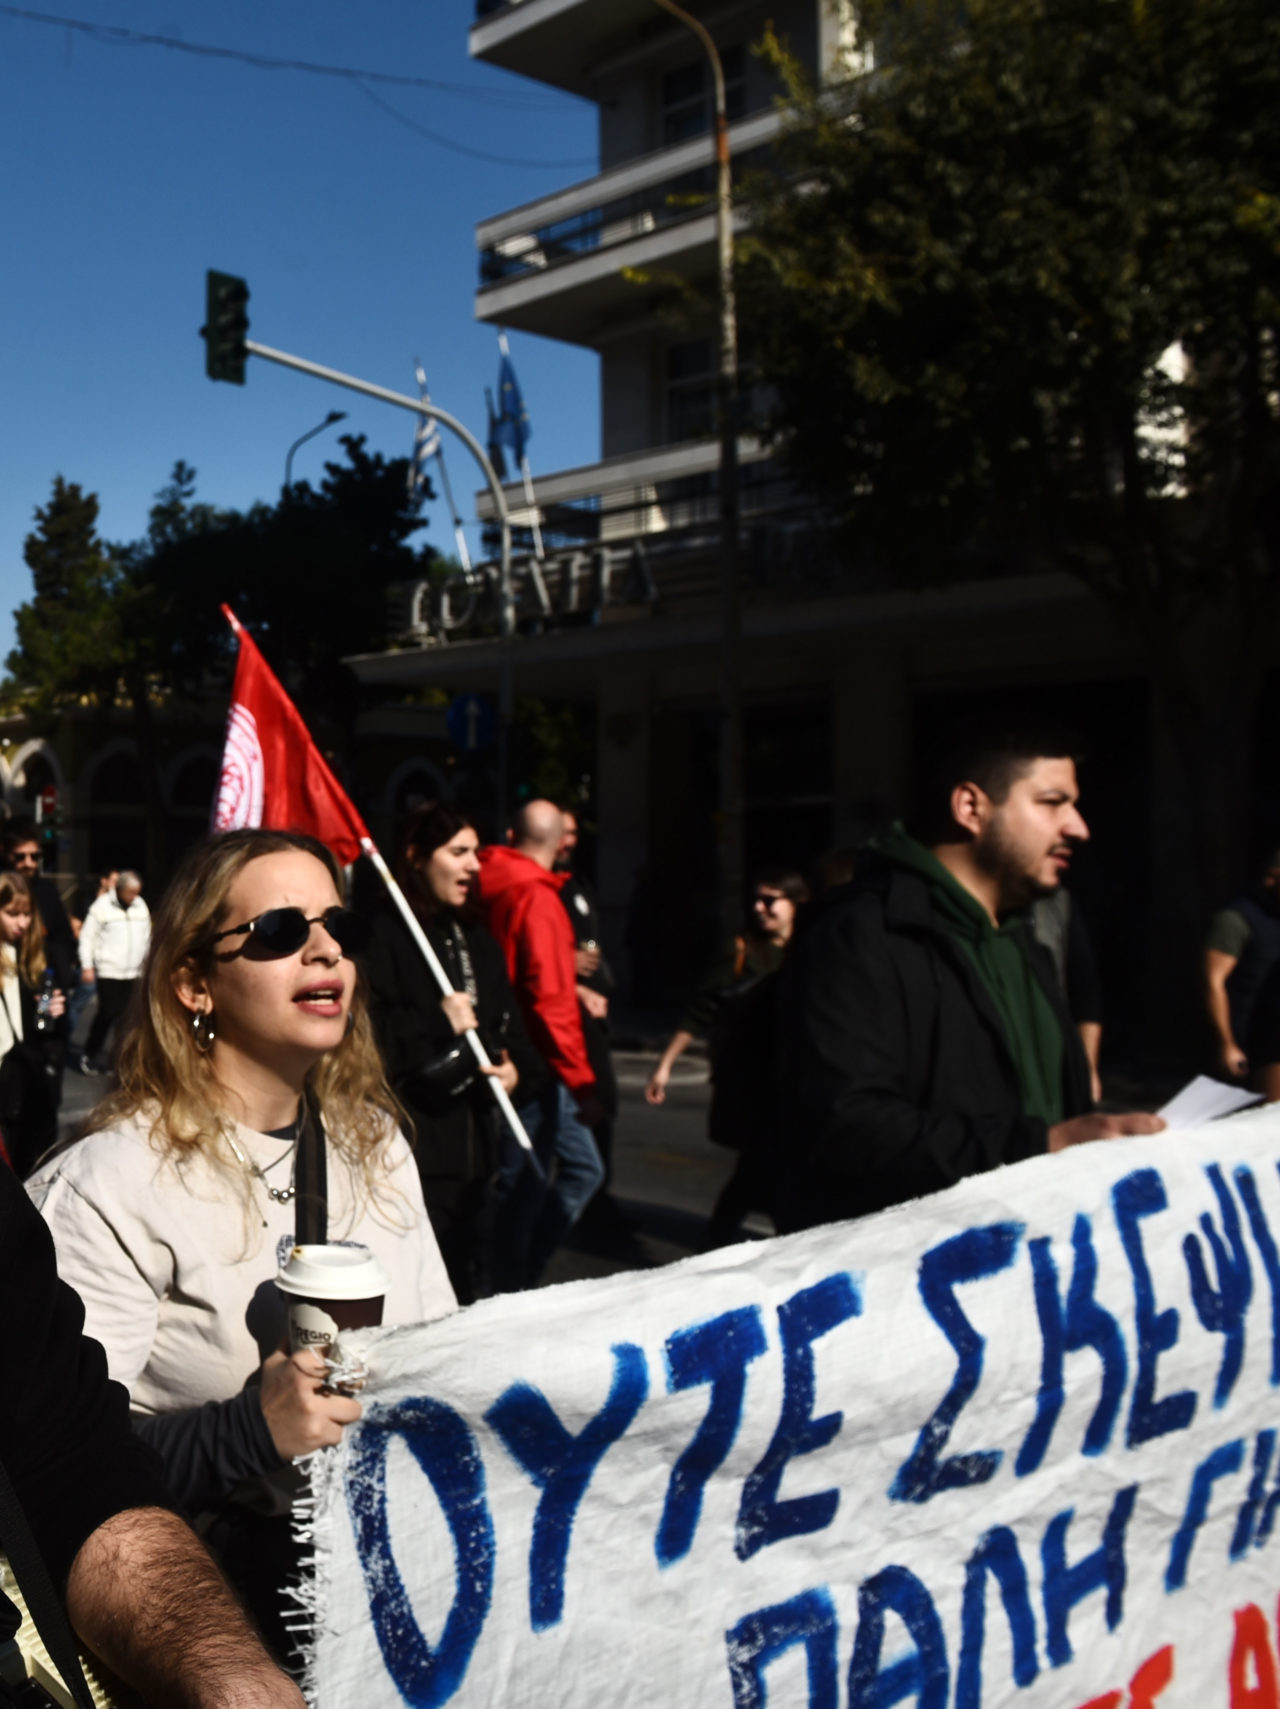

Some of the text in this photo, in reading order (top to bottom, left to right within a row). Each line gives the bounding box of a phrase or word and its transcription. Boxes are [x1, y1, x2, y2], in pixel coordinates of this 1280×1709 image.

[343, 1160, 1280, 1709] ΟΥΤΕ ΣΚΕΨΙ
[724, 1483, 1139, 1709] ΠΑΛΗ
